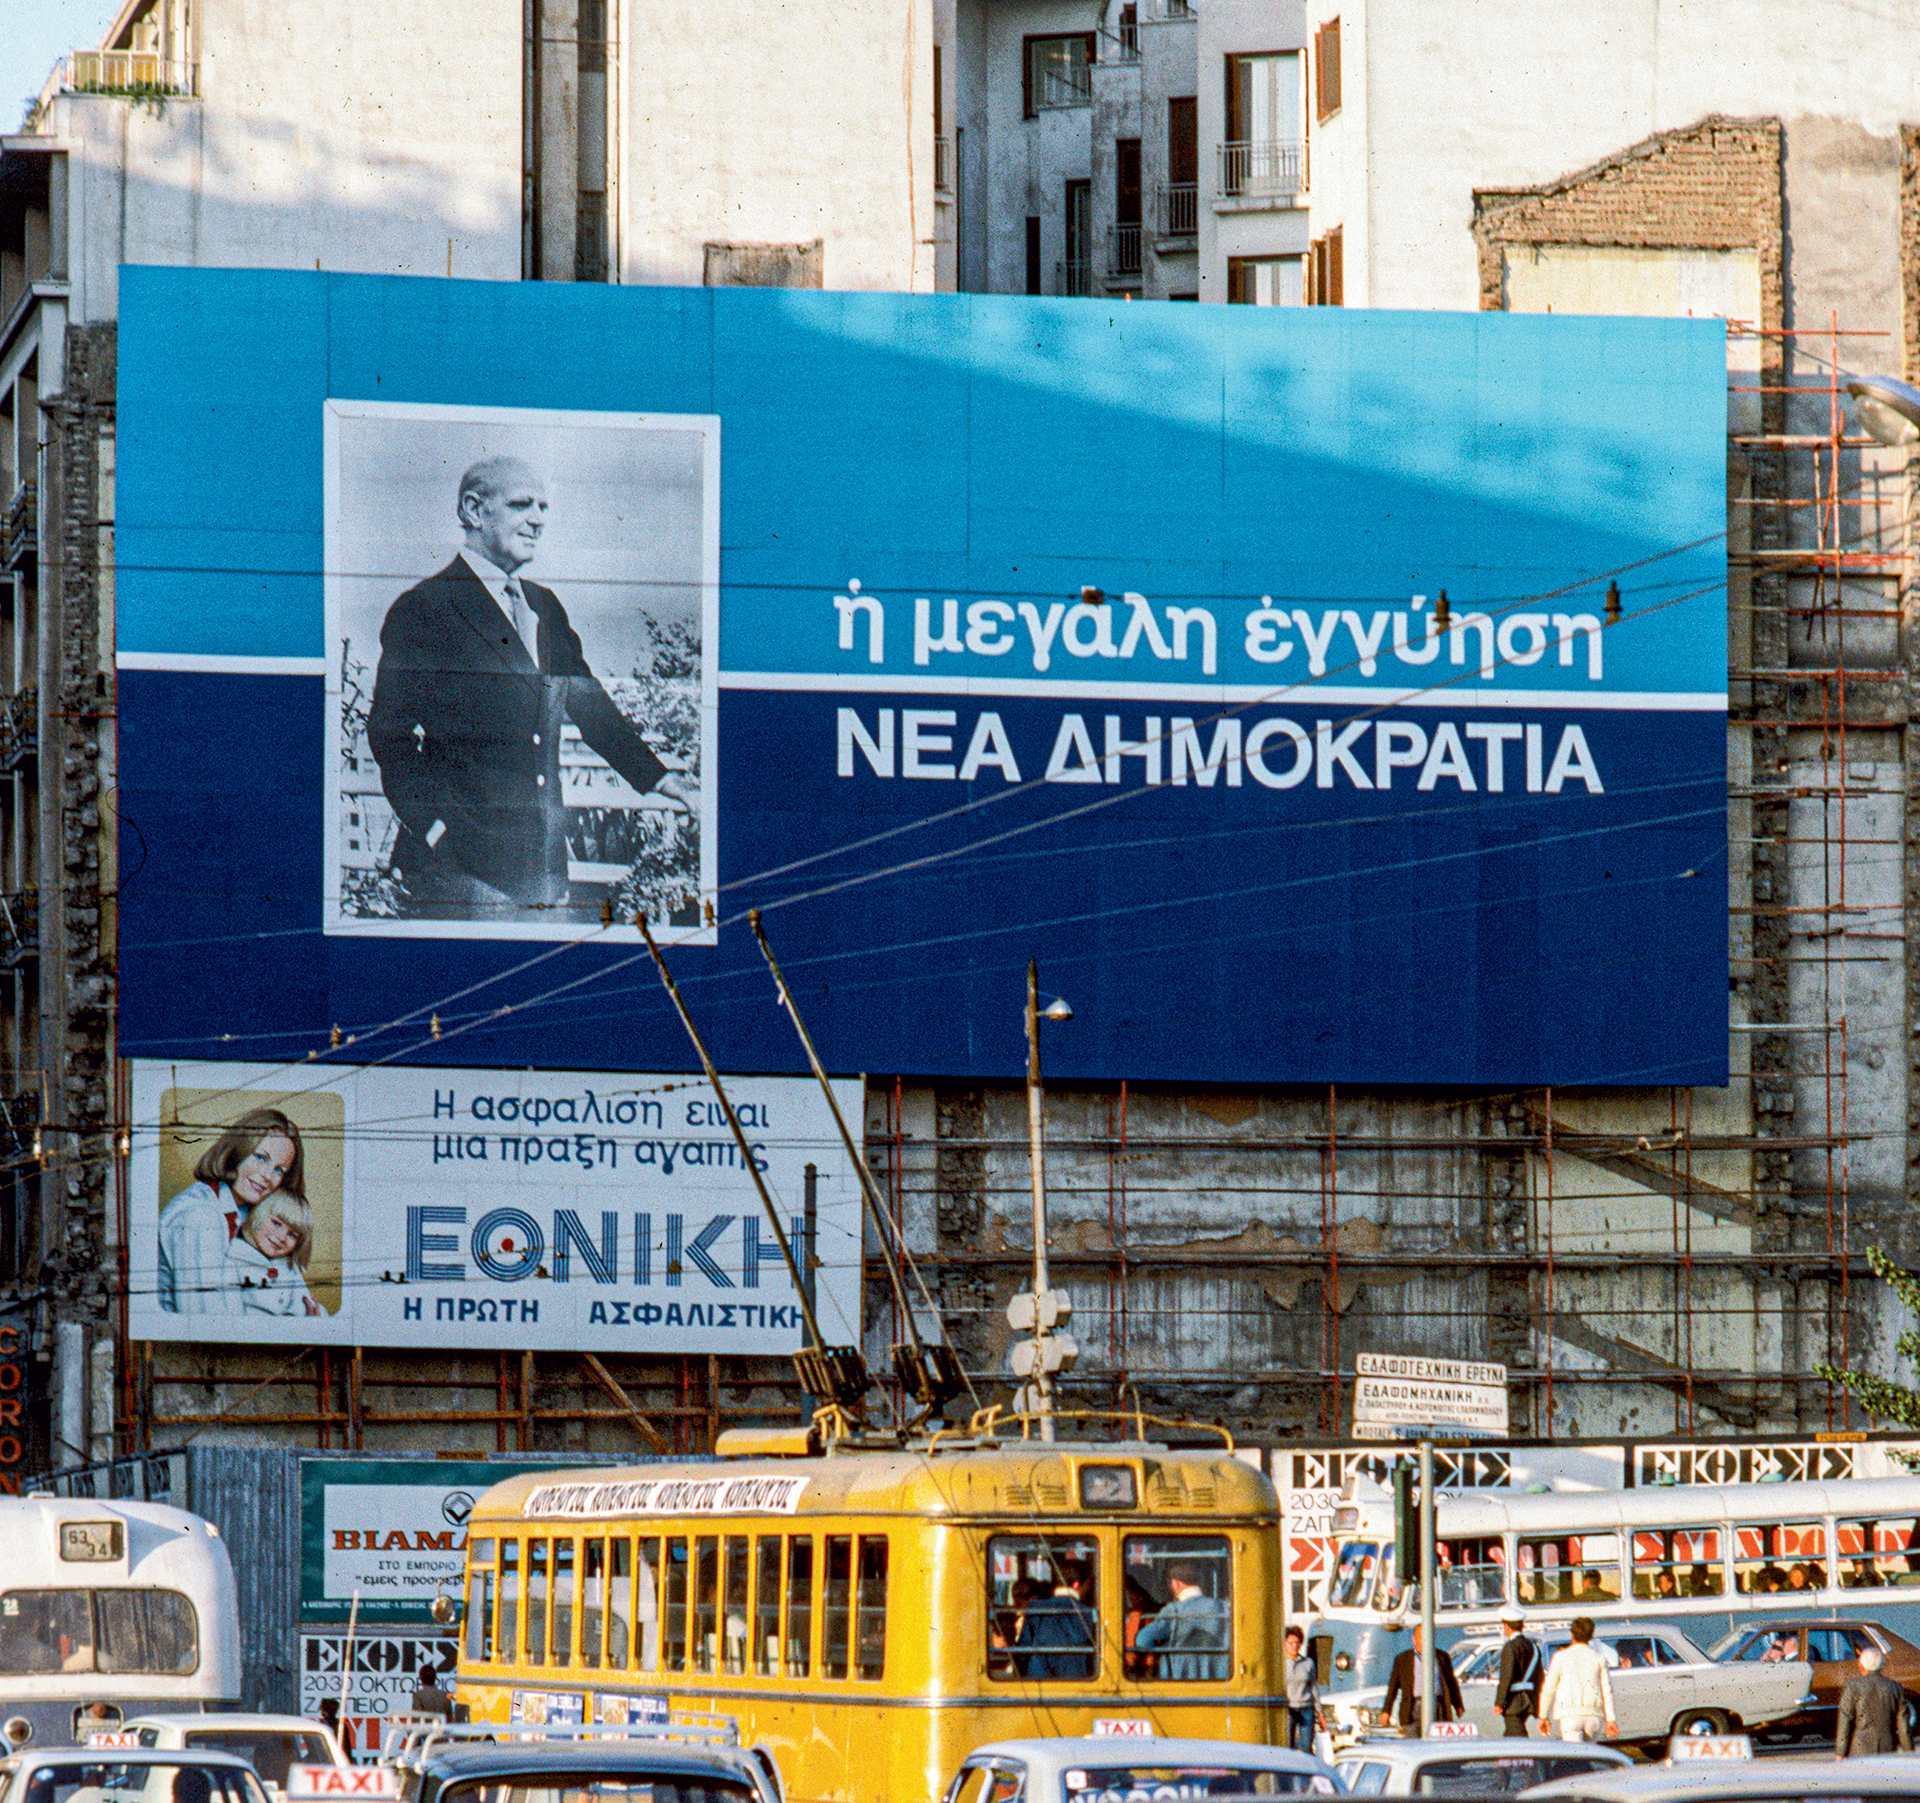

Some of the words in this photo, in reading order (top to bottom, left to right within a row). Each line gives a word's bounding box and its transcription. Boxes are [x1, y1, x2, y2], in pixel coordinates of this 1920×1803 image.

[837, 708, 1021, 781] ΝΕΑ
[1046, 714, 1604, 793] ΔΗΜΟΚΡΑΤΙΑ
[433, 1089, 454, 1119] Η
[472, 1089, 662, 1130] ασφαλιση
[686, 1101, 769, 1128] ειναι
[433, 1134, 487, 1164] μια
[500, 1133, 616, 1169] πραξη
[404, 1298, 422, 1320] Η
[436, 1299, 539, 1322] ΠΡΩΤΗ
[379, 1561, 399, 1570] ΣΤΟ
[306, 1638, 459, 1673] ΕΚΘΕΣ
[95, 1734, 135, 1746] TAXI
[1101, 1721, 1144, 1735] TAXI
[1436, 1724, 1475, 1737] TAXI
[1683, 1739, 1747, 1758] TAXI
[304, 1768, 384, 1792] TAXI
